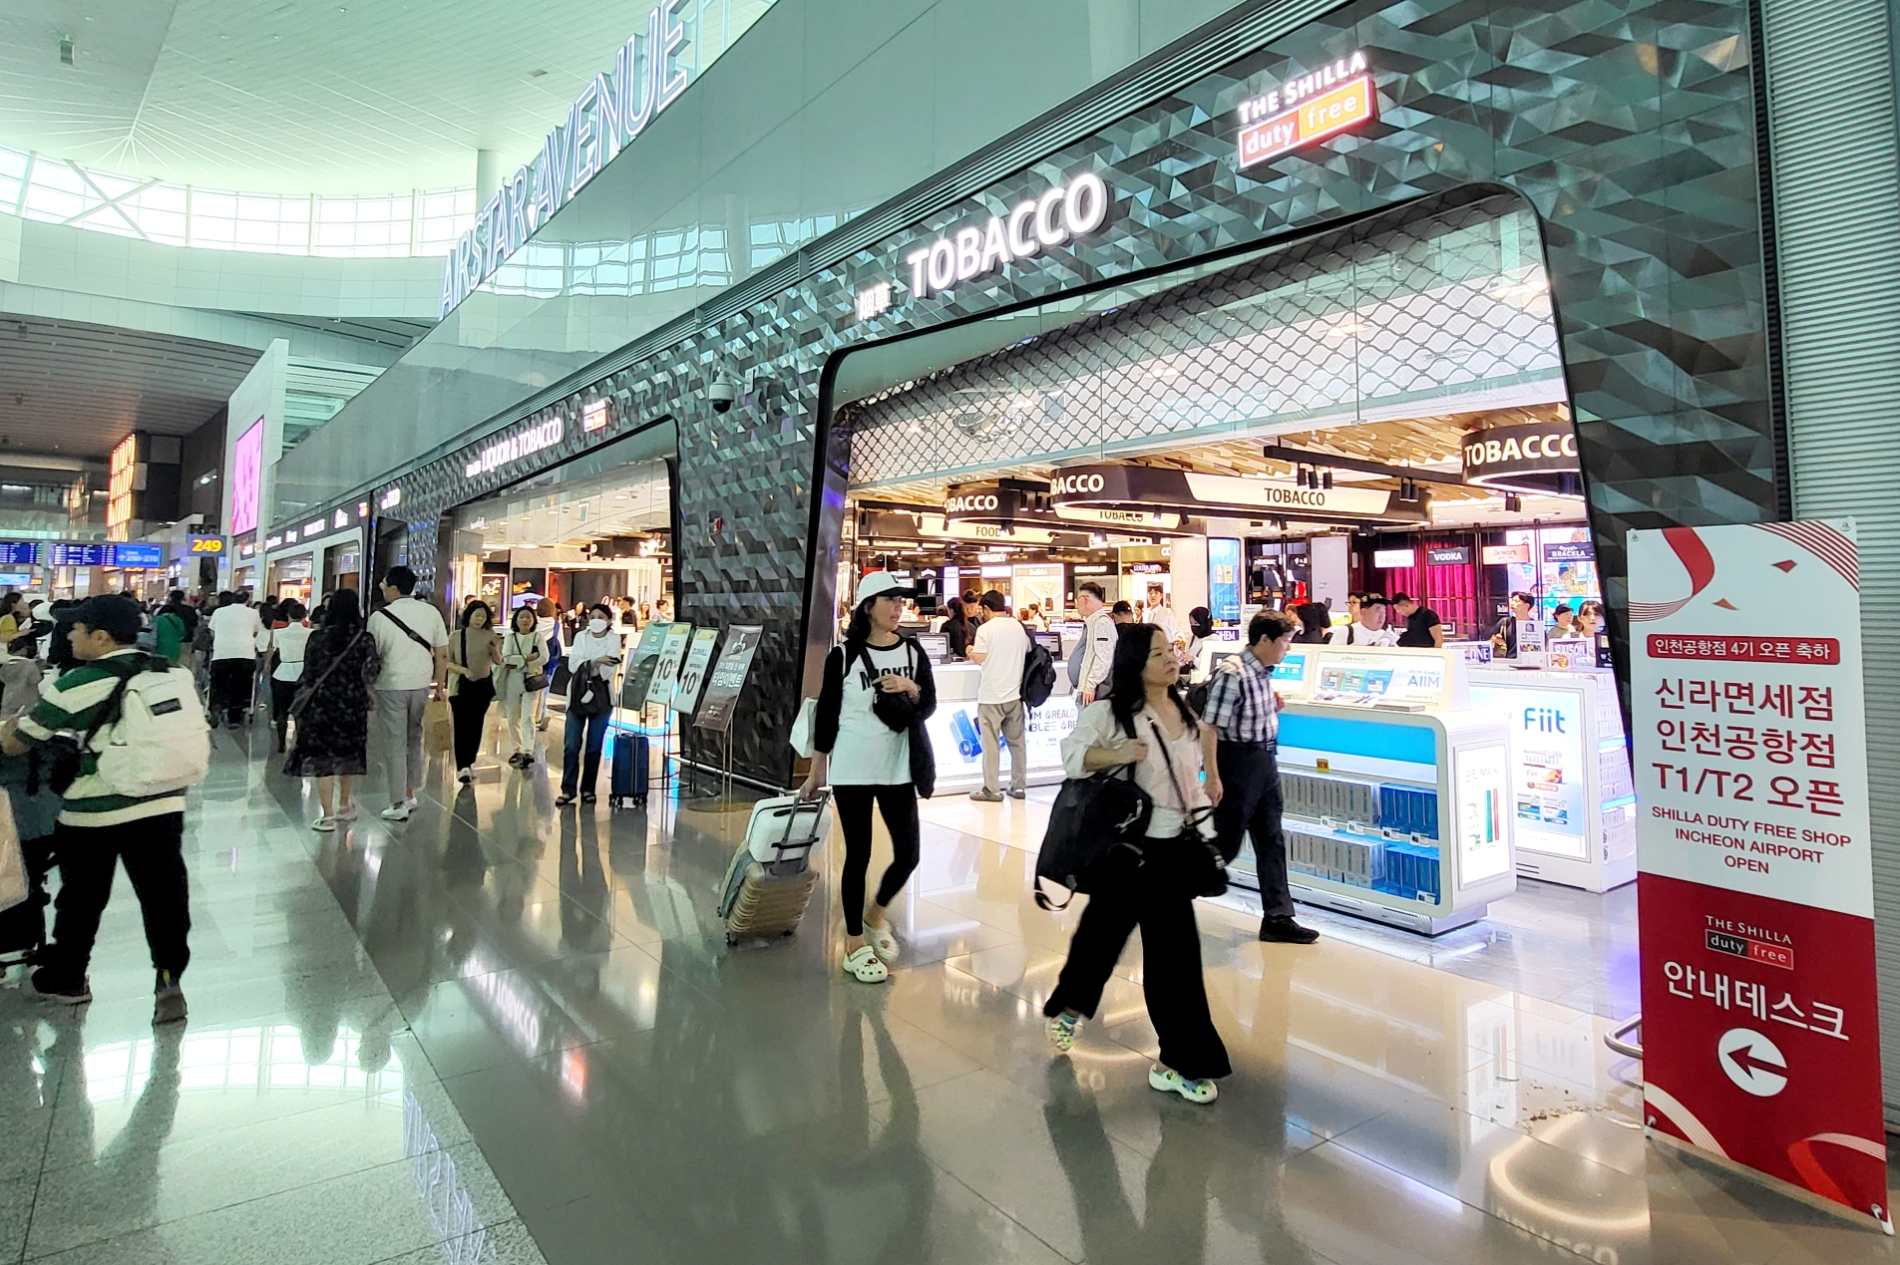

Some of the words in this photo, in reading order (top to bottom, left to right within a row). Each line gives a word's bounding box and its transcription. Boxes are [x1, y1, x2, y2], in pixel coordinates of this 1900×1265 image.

[1238, 91, 1279, 124] THE
[1284, 51, 1366, 104] SHILLA
[1246, 121, 1295, 154] duty
[1307, 96, 1357, 128] free
[438, 164, 534, 322] AIRSTAR
[534, 0, 690, 232] AVENUE
[906, 172, 1107, 298] TOBACCO
[481, 440, 510, 472] LIQUOR
[518, 417, 561, 456] TOBACCO
[1264, 487, 1326, 507] TOBACCO
[192, 538, 222, 552] 249
[976, 526, 1000, 537] FOOD
[1434, 552, 1462, 561] VODKA
[1551, 550, 1586, 558] BRACKLA
[1655, 638, 1726, 656] 인천공항점
[1731, 642, 1753, 657] 4기
[1759, 643, 1792, 659] 오픈
[1796, 642, 1830, 660] 축하
[657, 658, 673, 680] 10
[681, 672, 697, 695] 10
[1655, 678, 1834, 722] 신라면세점
[1524, 708, 1565, 734] Fiit
[1656, 720, 1836, 769] 인천공항점
[1652, 762, 1754, 802] T1/T2
[1767, 775, 1844, 817] 오픈
[1652, 806, 1703, 824] SHILLA
[1708, 814, 1750, 832] DUTY
[1754, 822, 1797, 840] FREE
[1802, 829, 1851, 848] SHOP
[1675, 828, 1746, 851] INCHEON
[1750, 840, 1824, 864] AIRPORT
[1725, 855, 1769, 874] OPEN
[1706, 915, 1734, 931] THE
[1738, 921, 1792, 945] SHILLA
[1710, 935, 1745, 956] duty
[1753, 945, 1788, 963] free
[1663, 960, 1850, 1042] 안내데스크
